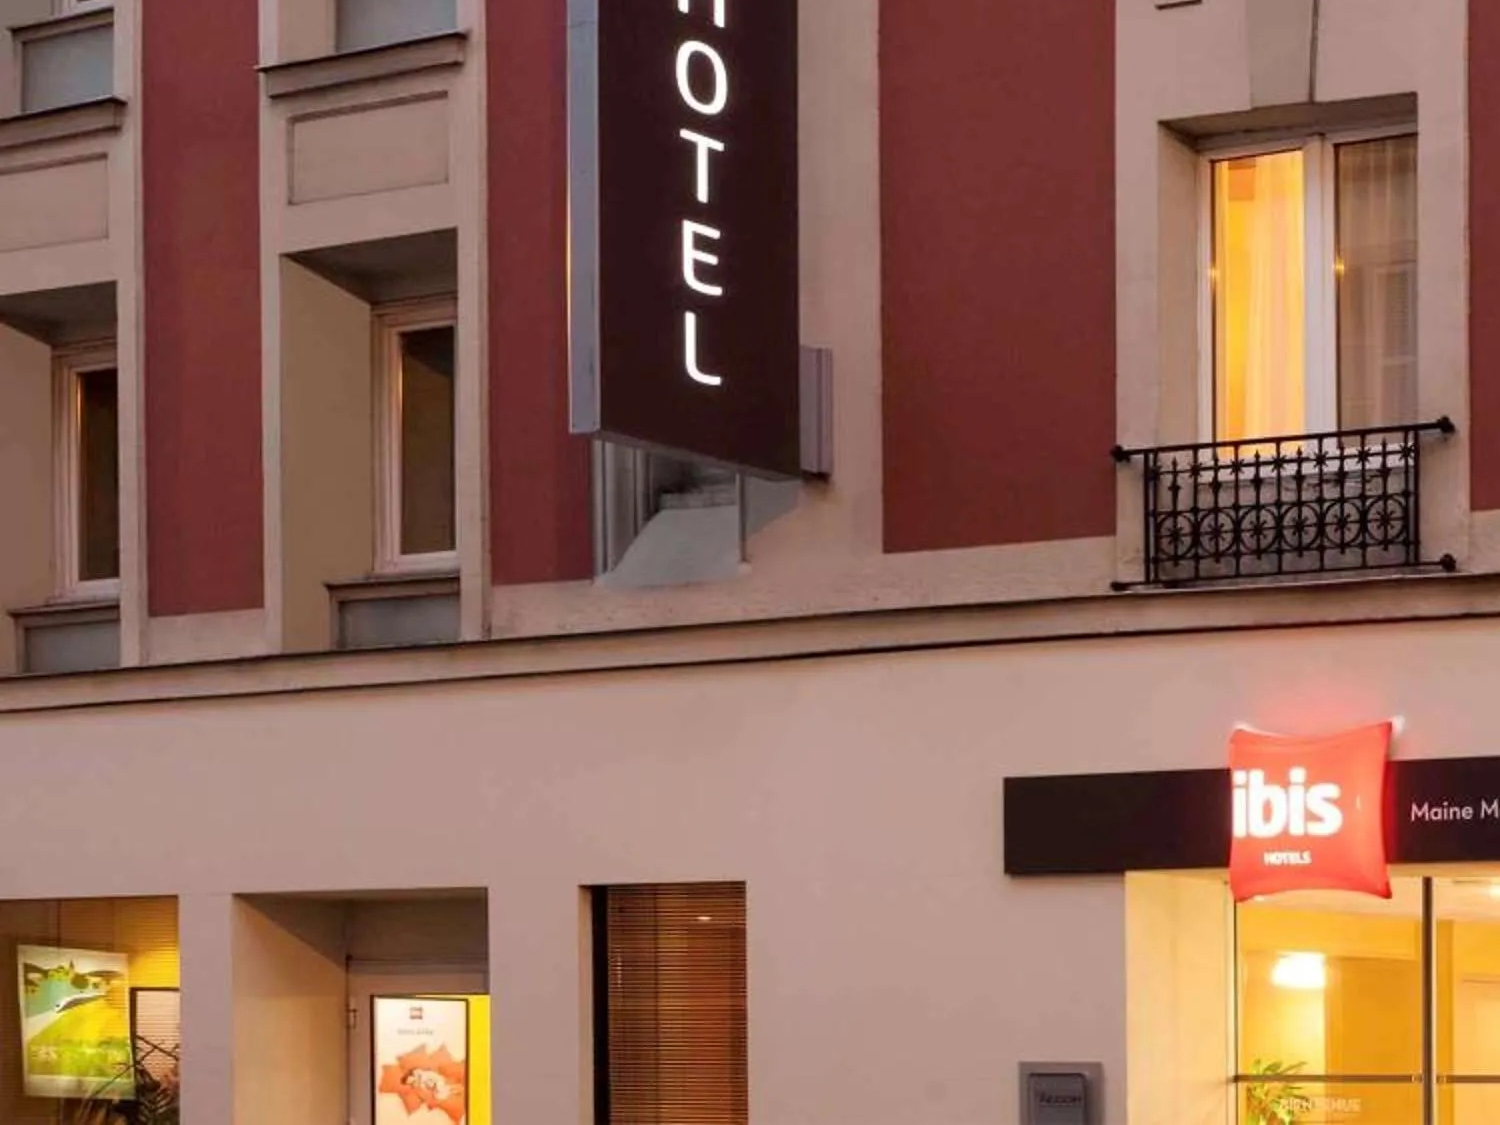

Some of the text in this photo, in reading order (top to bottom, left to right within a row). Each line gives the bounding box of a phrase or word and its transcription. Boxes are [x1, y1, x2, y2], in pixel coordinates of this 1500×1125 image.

[1231, 765, 1343, 839] ibis
[1410, 801, 1474, 822] Maine
[1263, 849, 1313, 866] HOTELS
